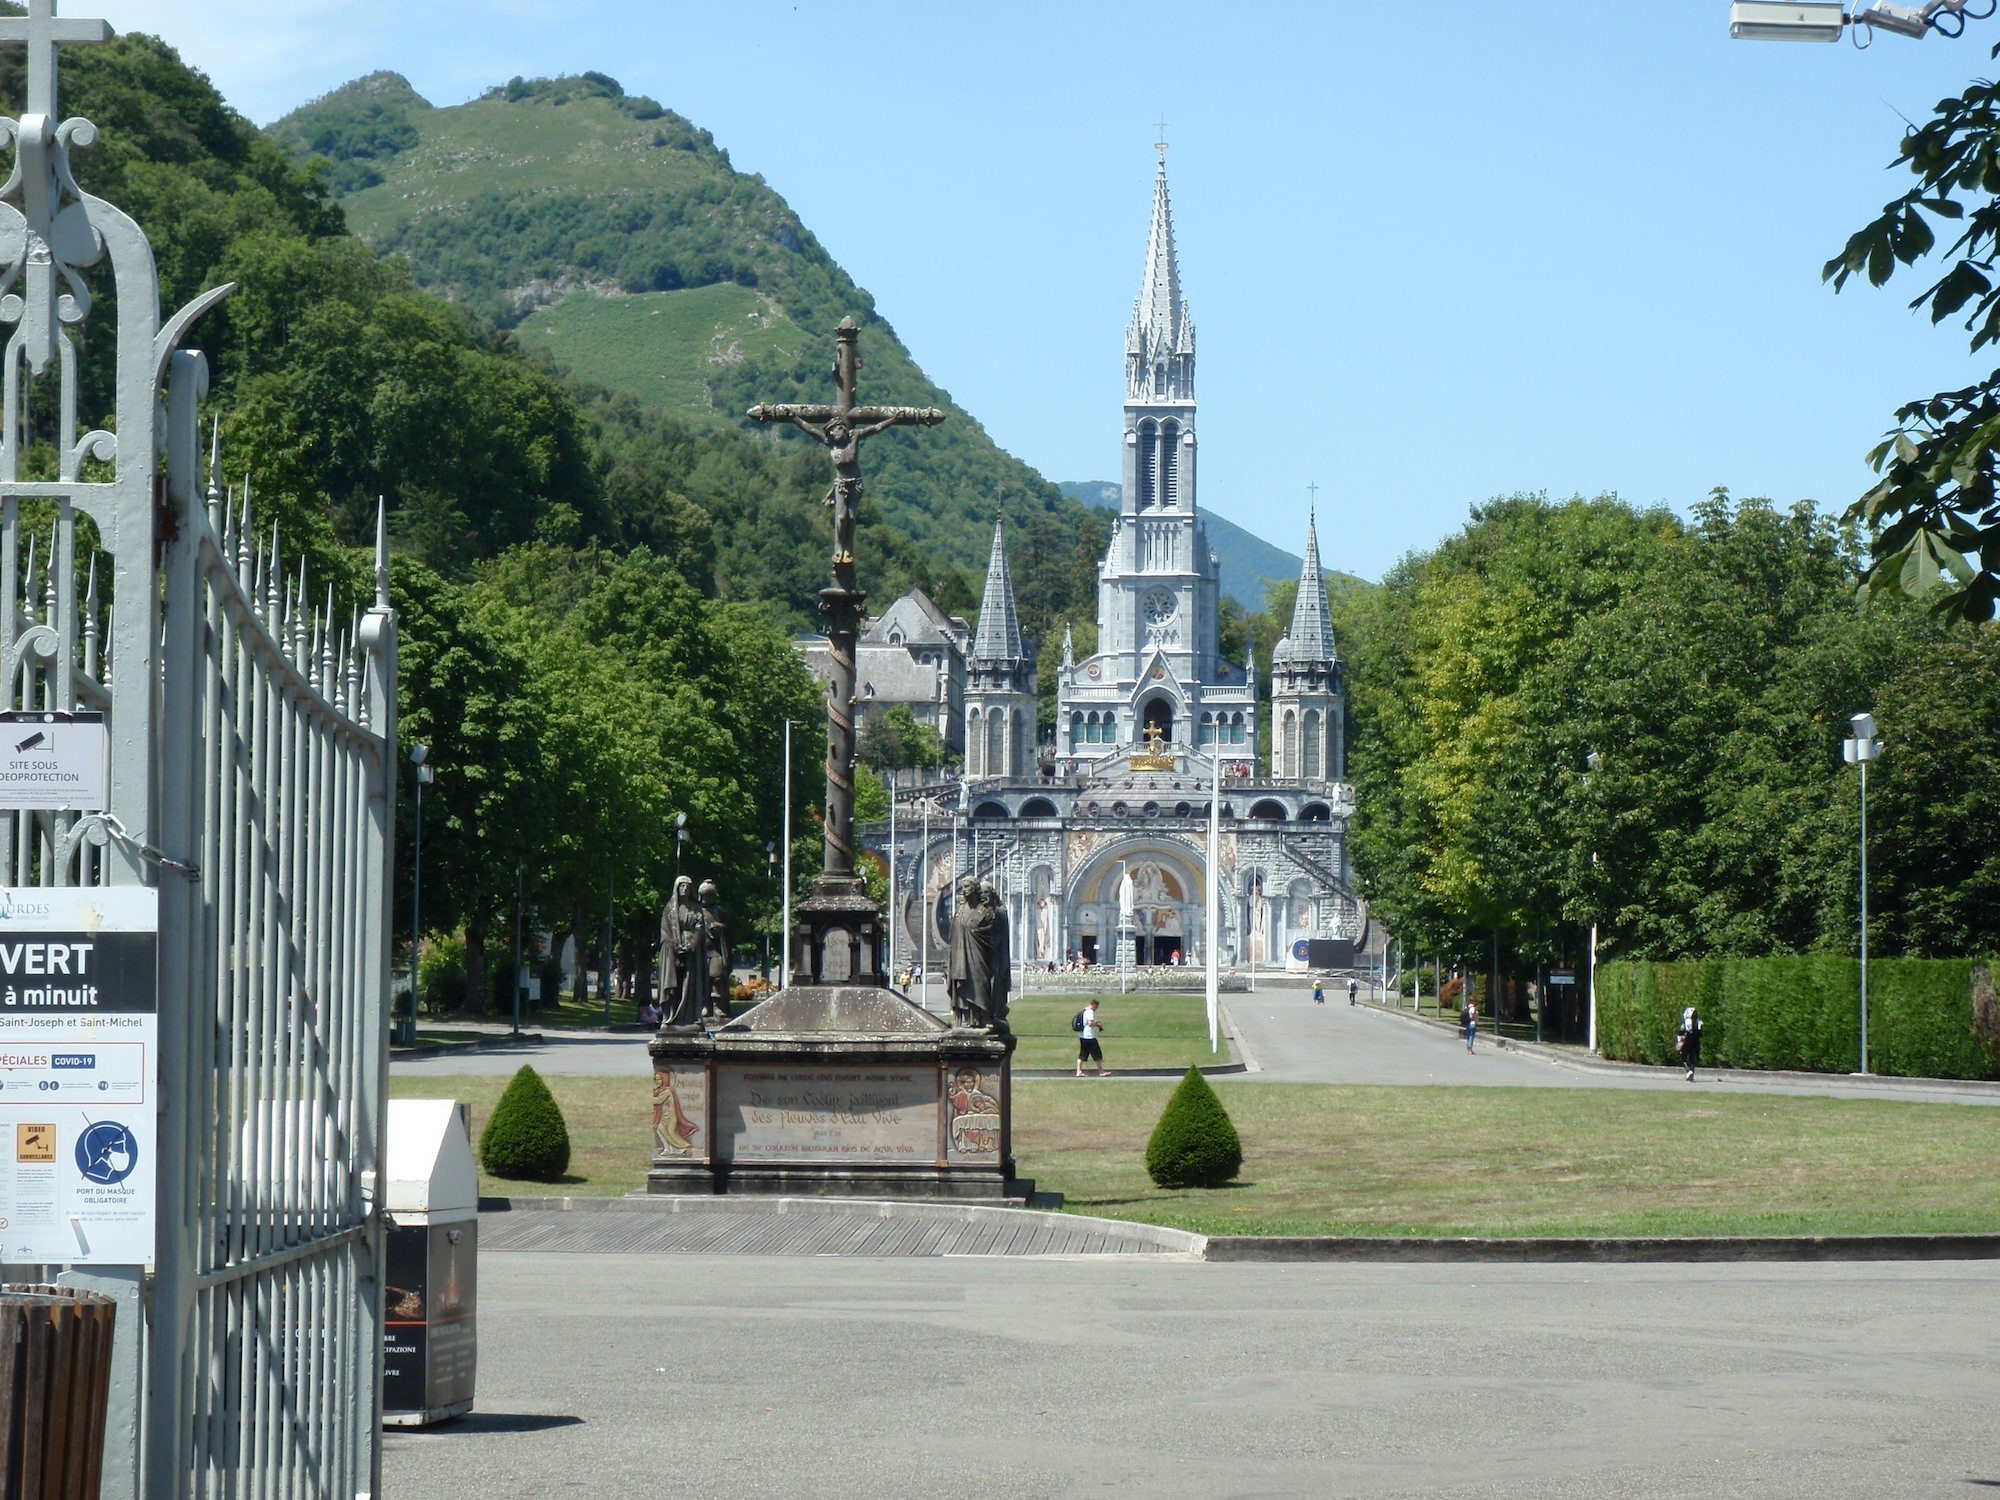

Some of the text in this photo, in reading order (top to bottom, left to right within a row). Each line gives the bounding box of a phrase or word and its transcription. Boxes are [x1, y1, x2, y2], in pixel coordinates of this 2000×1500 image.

[9, 761, 58, 770] SITE SOUS
[0, 903, 49, 914] URDES
[0, 943, 94, 975] VERT
[5, 984, 98, 1006] à minuit
[0, 1017, 142, 1030] Saint-Joseph et Saint-Michel
[0, 1054, 93, 1066] ÉCIALES COVID-19
[777, 1095, 798, 1106] son
